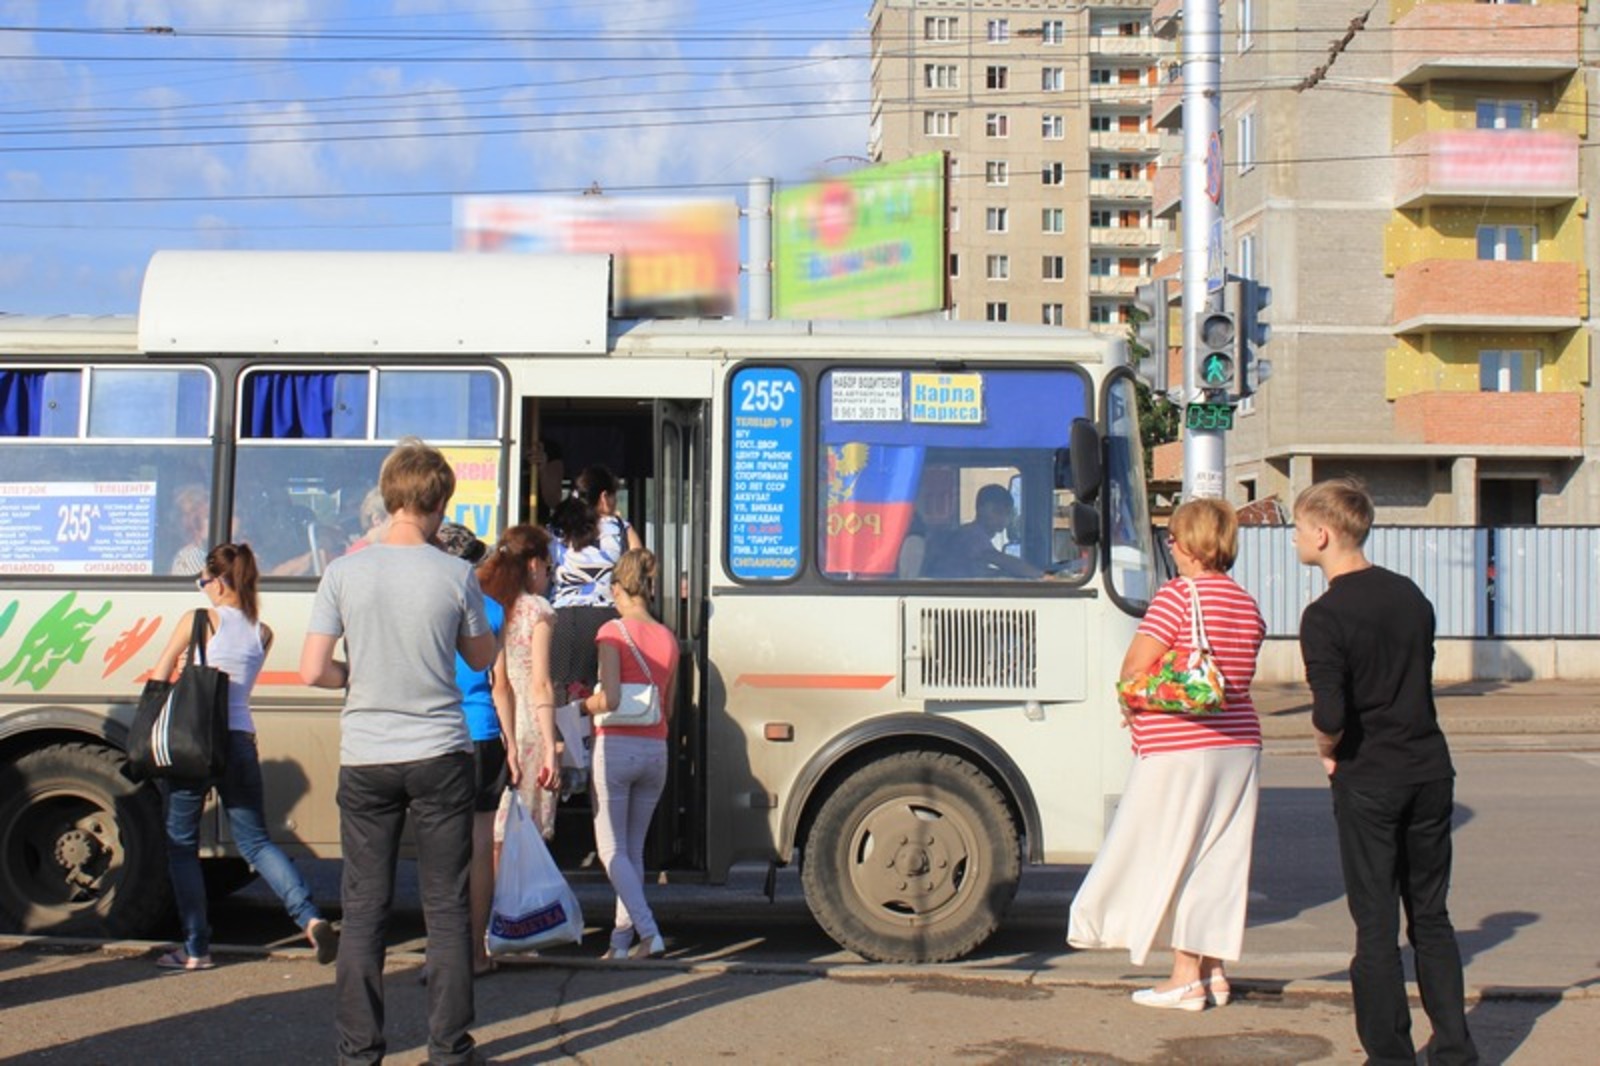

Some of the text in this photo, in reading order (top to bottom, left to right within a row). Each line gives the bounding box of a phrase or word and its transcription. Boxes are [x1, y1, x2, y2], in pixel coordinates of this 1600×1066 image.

[833, 375, 901, 390] НАБОР ВОДИТЕЛЕЙ
[915, 384, 976, 404] Карла
[913, 403, 979, 421] Маркса
